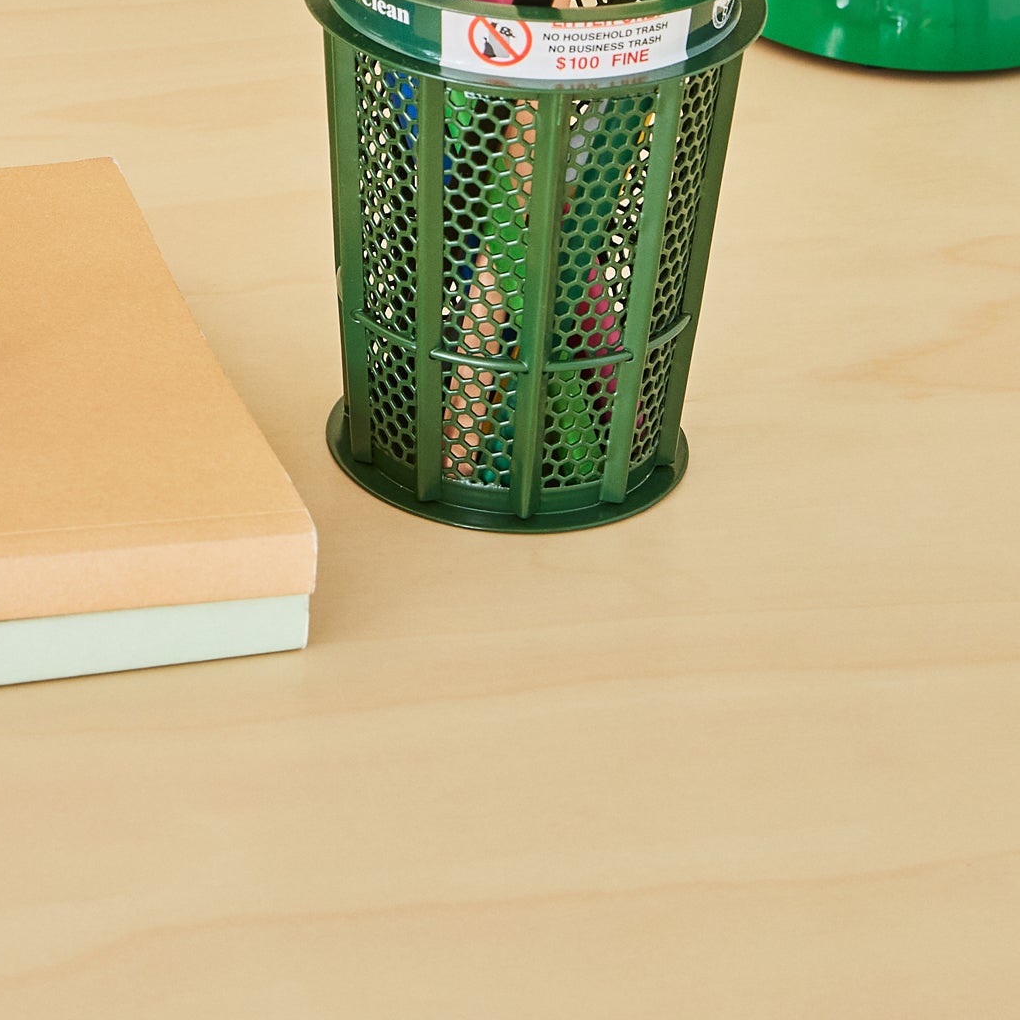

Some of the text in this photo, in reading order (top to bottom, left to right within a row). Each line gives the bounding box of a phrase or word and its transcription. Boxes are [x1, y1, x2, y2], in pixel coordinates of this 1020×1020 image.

[542, 21, 669, 42] NO HOUSEHOLD TRASH
[548, 35, 662, 53] NO BUSINESS TRASH
[555, 49, 650, 72] $100 FINE
